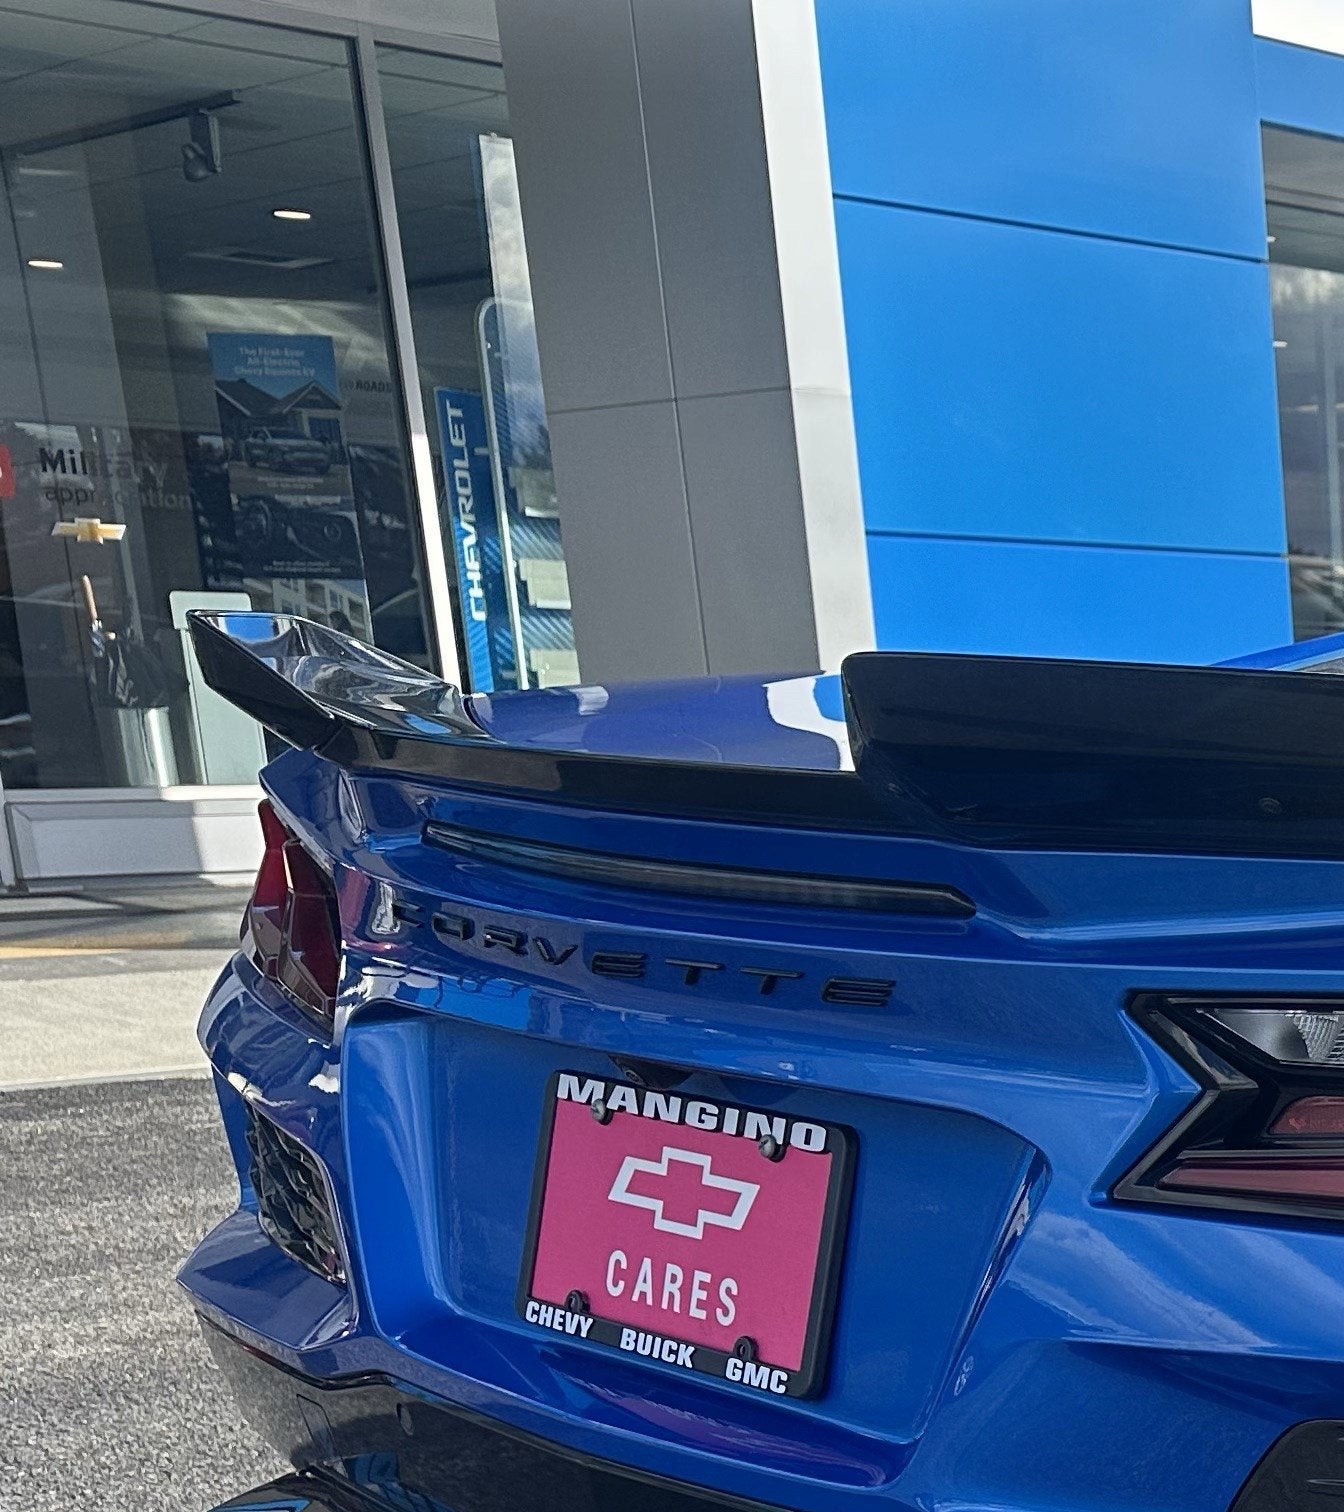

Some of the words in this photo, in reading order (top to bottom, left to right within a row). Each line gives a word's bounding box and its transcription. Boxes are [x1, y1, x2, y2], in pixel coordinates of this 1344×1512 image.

[446, 399, 487, 621] CHEVROLET
[389, 900, 895, 1007] CORVETTE
[556, 1073, 827, 1153] MANGINO
[605, 1249, 739, 1327] CARES
[525, 1300, 594, 1338] CHEVY
[619, 1327, 696, 1369] BUICK
[725, 1357, 789, 1395] GMC
